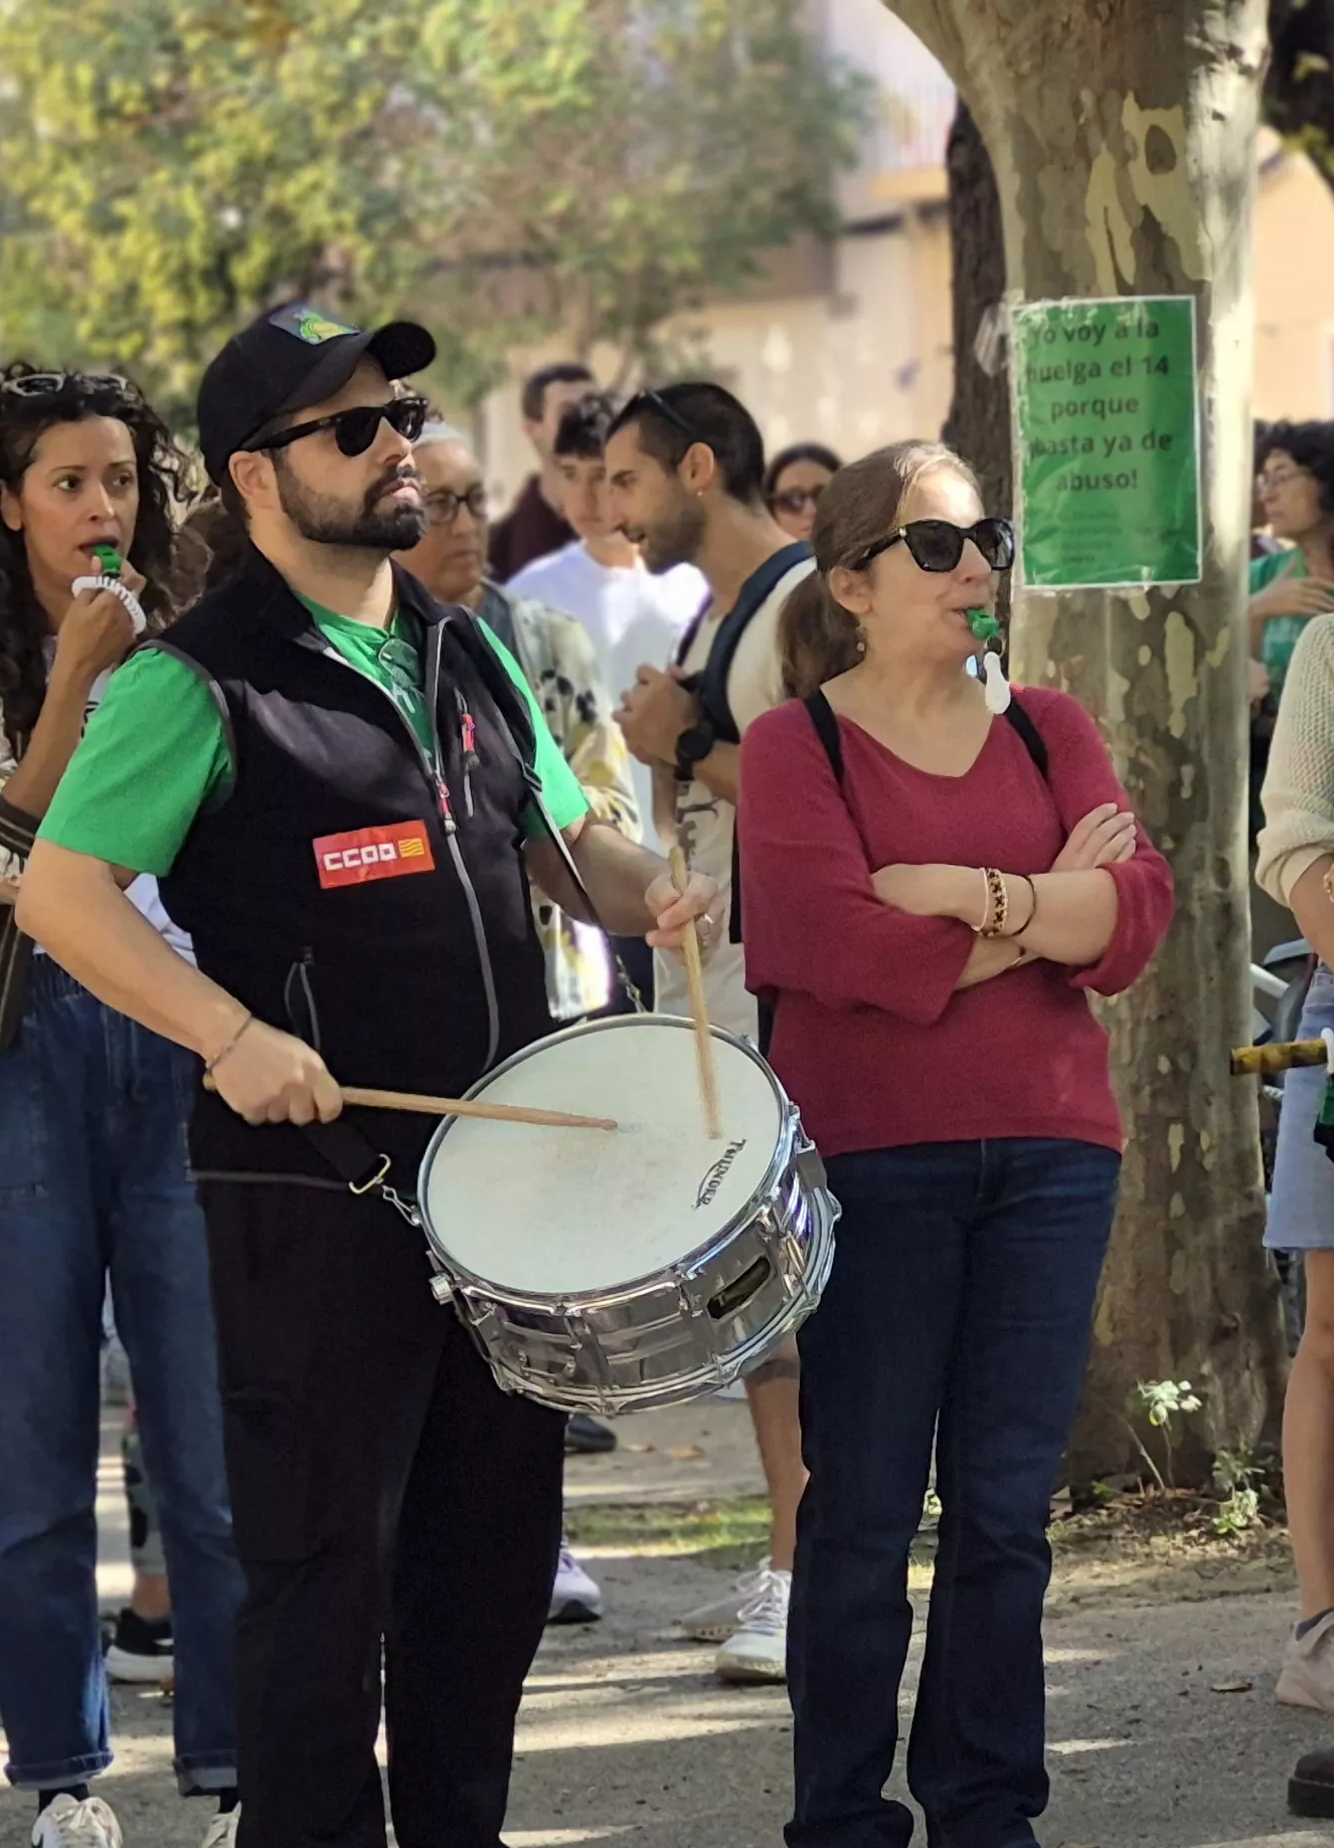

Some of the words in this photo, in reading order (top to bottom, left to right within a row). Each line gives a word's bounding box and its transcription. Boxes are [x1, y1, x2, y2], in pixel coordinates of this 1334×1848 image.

[1063, 323, 1106, 346] voy
[1115, 324, 1128, 339] a
[1137, 319, 1160, 338] la
[1026, 360, 1101, 386] huelga
[1110, 355, 1131, 377] el
[1141, 354, 1169, 375] 14
[1051, 396, 1139, 423] porque
[1103, 434, 1132, 458] ya
[1141, 428, 1172, 451] de
[1056, 469, 1138, 491] abuso!
